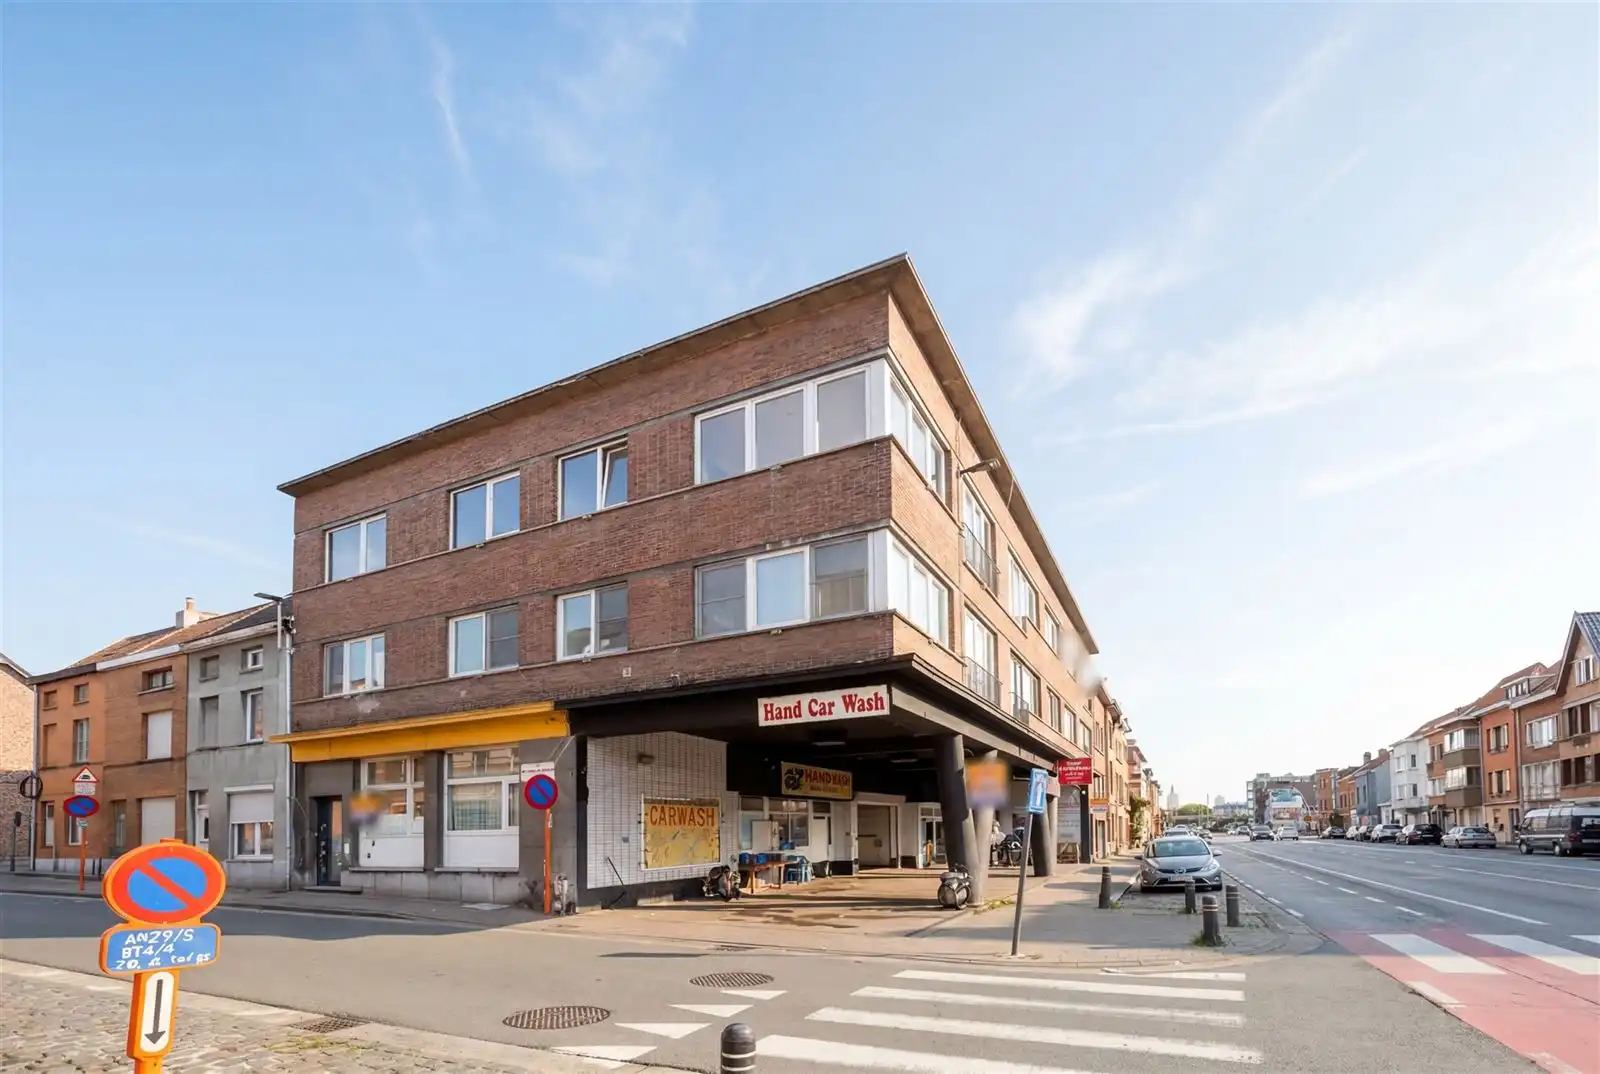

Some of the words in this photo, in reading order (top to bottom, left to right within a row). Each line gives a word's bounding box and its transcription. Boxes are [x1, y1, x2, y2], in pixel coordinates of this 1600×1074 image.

[763, 700, 802, 721] Hand
[808, 698, 835, 717] Car
[841, 691, 885, 714] Wash
[650, 805, 715, 827] CARWASH
